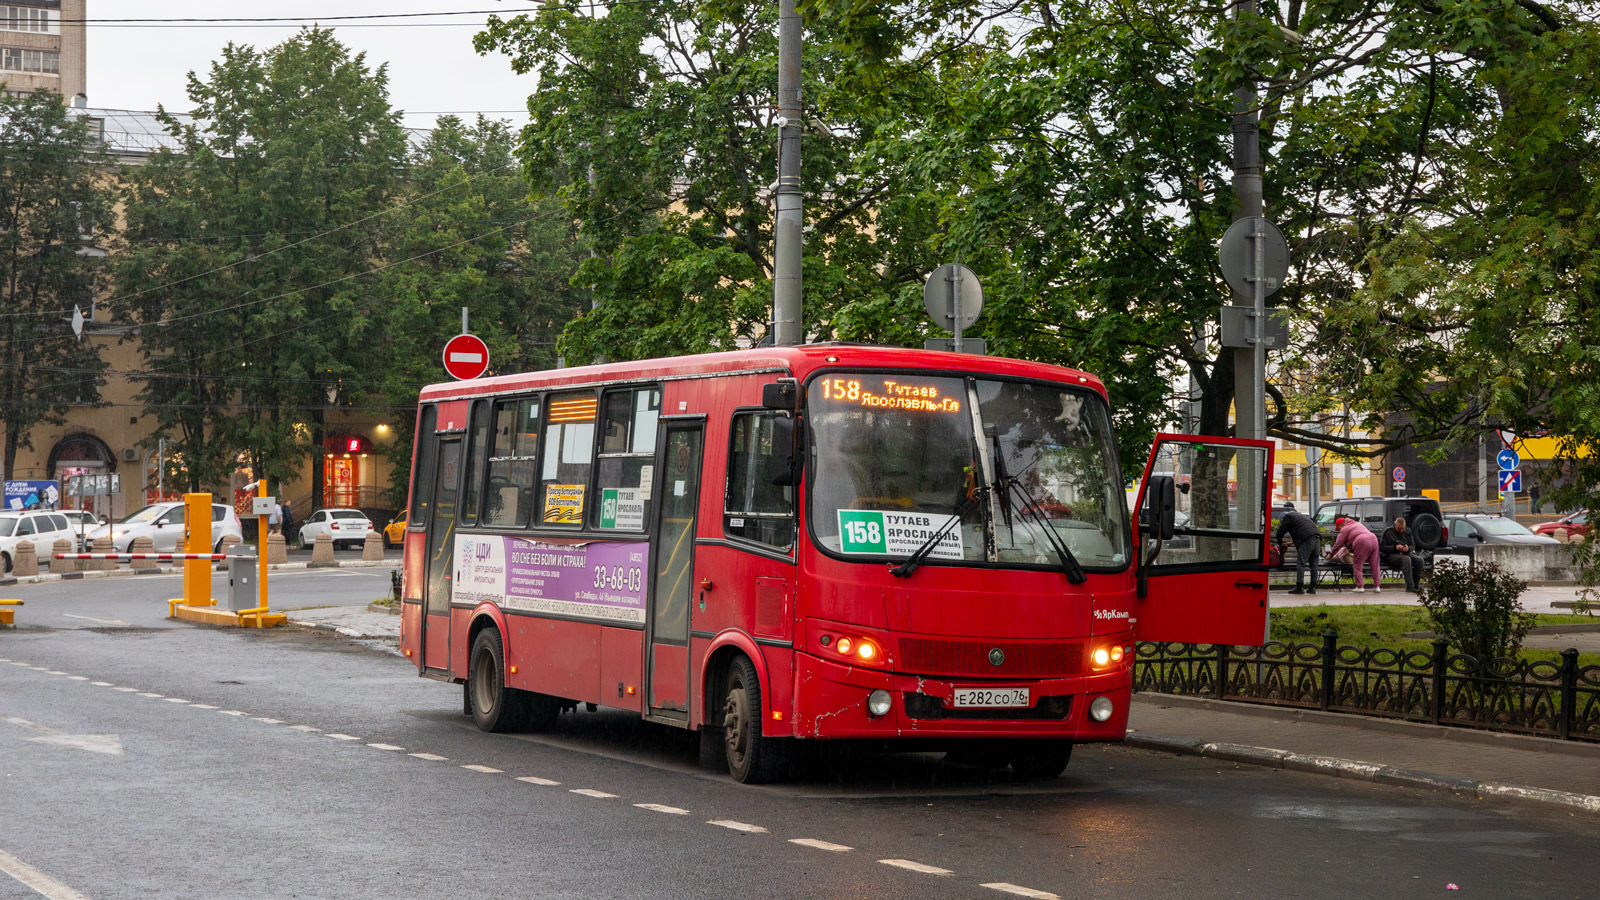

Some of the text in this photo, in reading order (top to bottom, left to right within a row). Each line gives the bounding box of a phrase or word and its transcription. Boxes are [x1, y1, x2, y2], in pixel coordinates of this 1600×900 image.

[822, 379, 860, 400] 158
[884, 381, 937, 397] Тутаев
[861, 392, 960, 413] Ярославль-Гл
[619, 492, 634, 500] ТУТАЕВ
[603, 498, 616, 520] 158
[618, 504, 643, 513] ЯРОСЛАВЛЬ
[886, 515, 930, 526] ТУТАЕВ
[844, 521, 881, 544] 158
[476, 543, 491, 562] ЦДИ
[512, 552, 586, 568] ВО СНЕ БЕЗ БОЛИ И СТРАХА!
[594, 565, 641, 592] 33-68-03
[1013, 690, 1025, 700] 76
